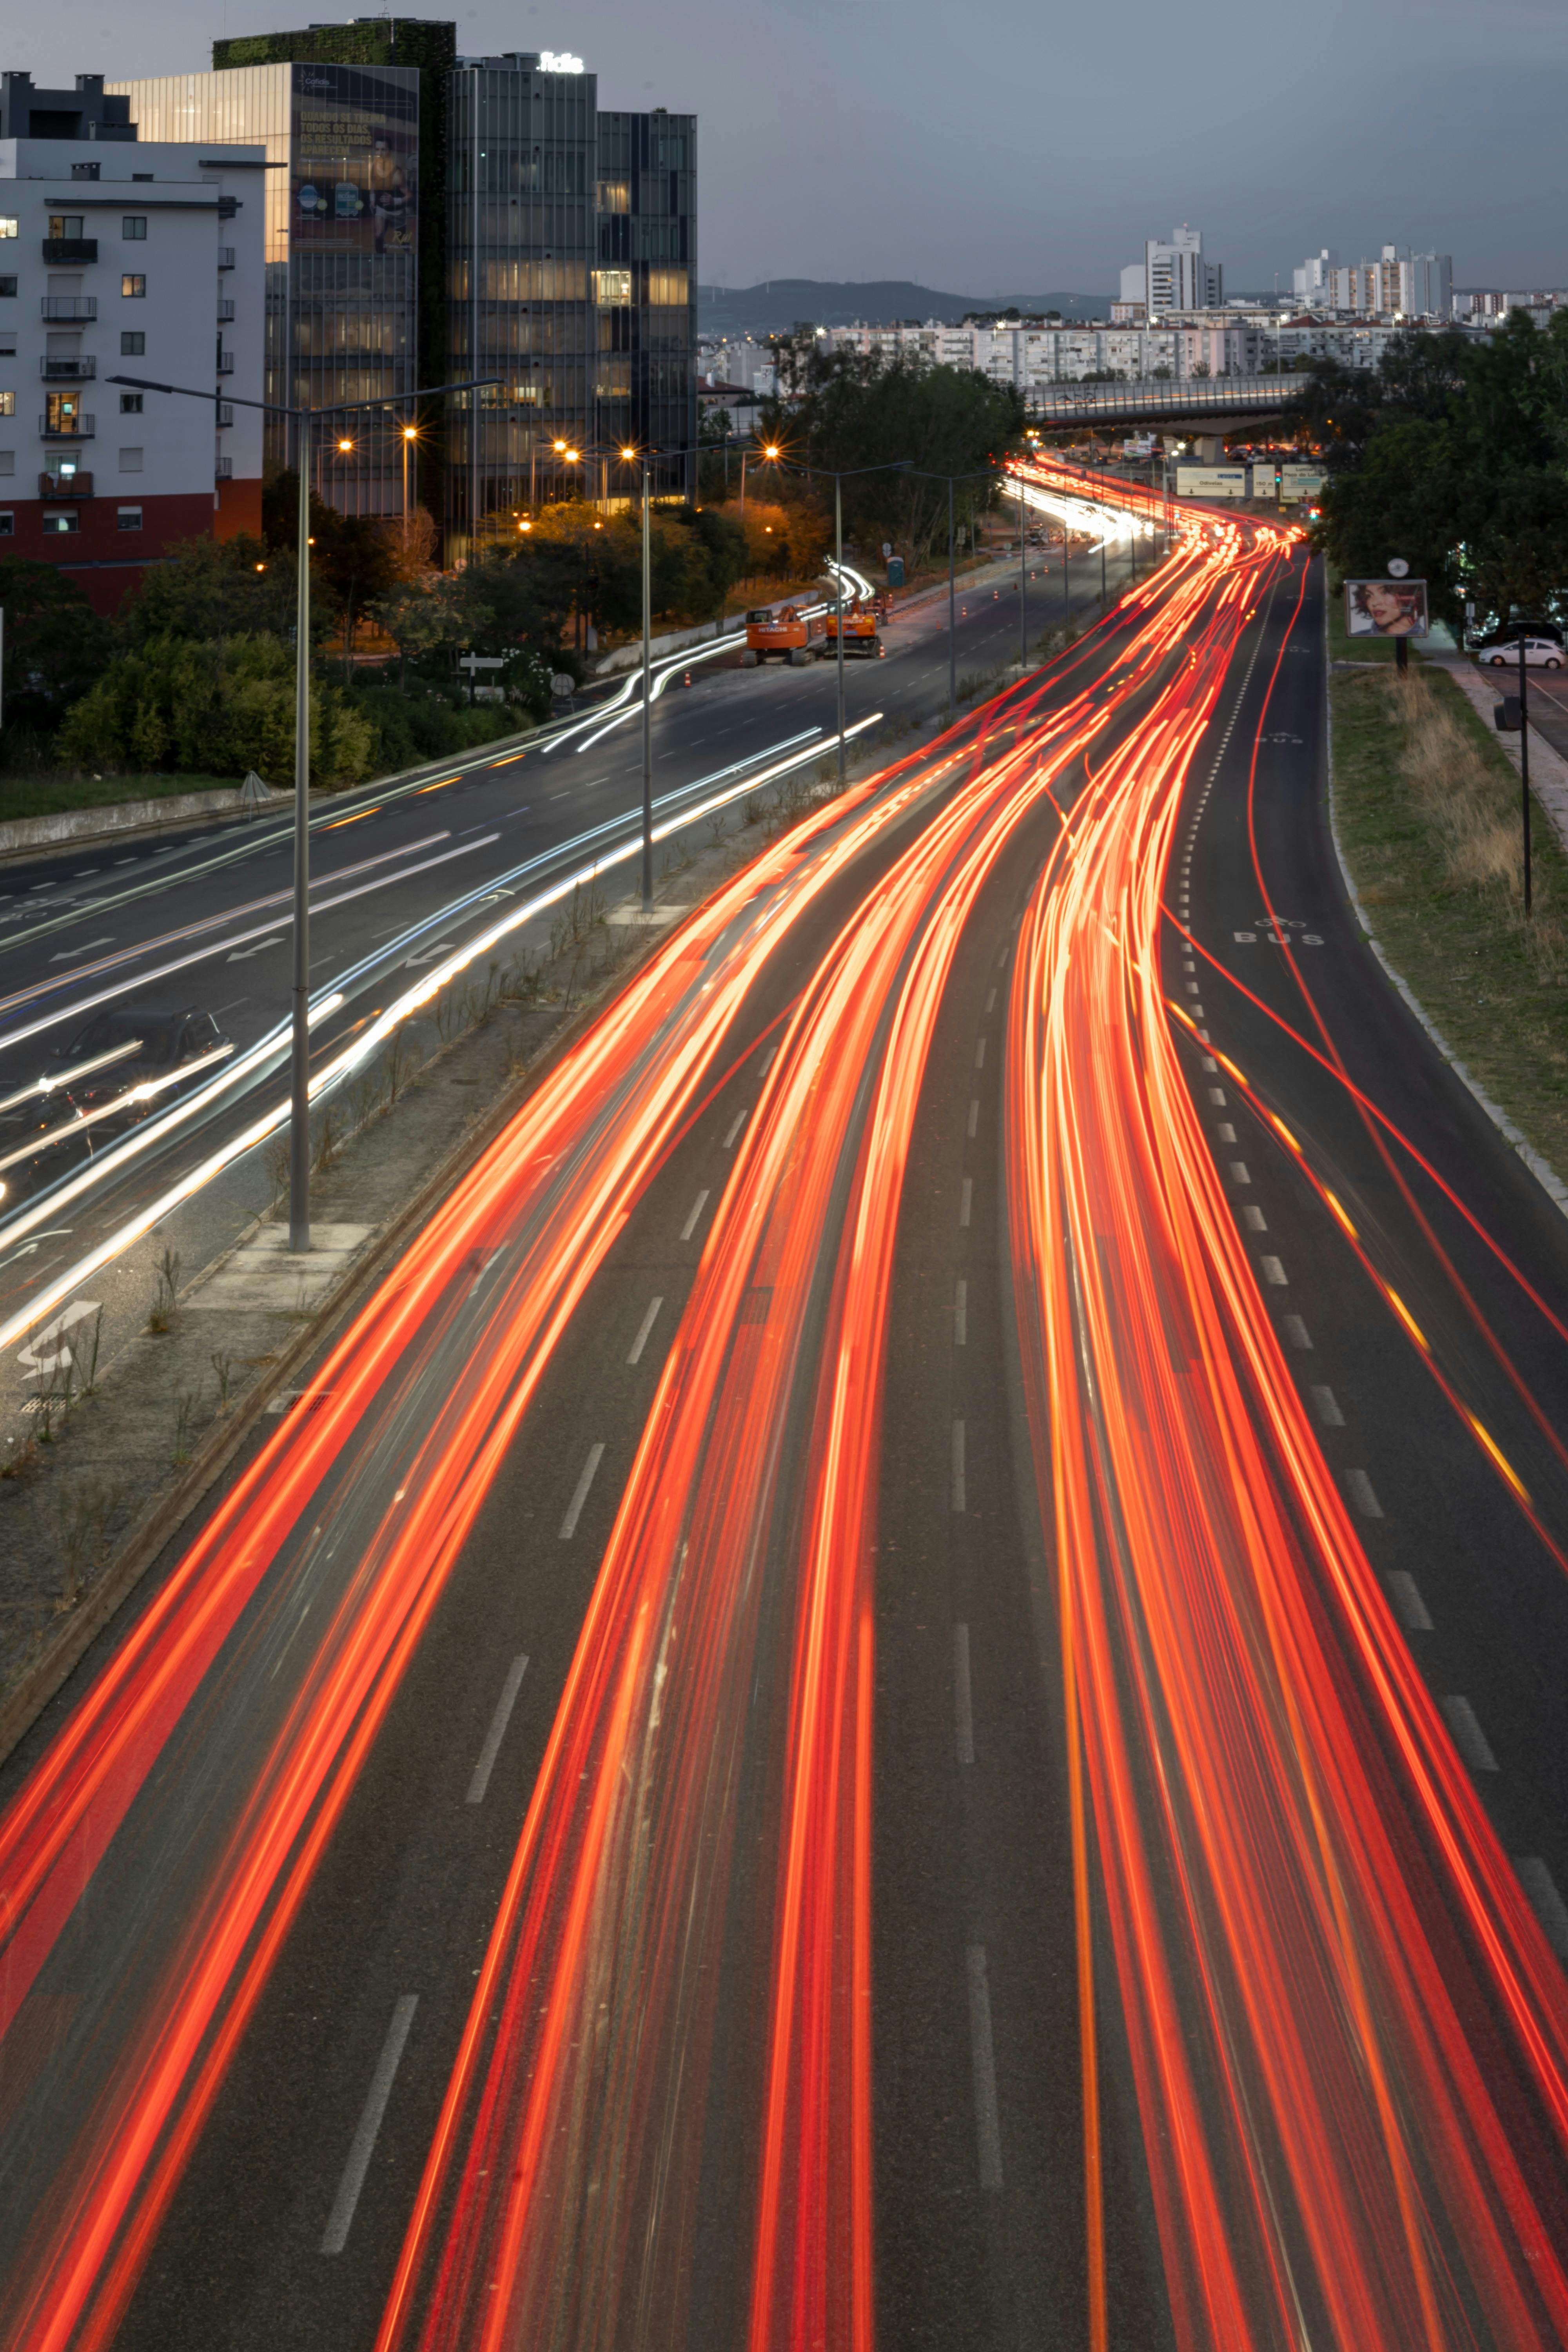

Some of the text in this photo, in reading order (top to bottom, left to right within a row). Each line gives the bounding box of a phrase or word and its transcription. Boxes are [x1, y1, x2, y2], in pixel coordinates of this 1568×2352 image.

[301, 112, 386, 123] QUANDO SE TREINA
[301, 122, 370, 134] TODOS OS DIAS,
[301, 133, 372, 145] OS RESULTADOS
[1233, 932, 1325, 945] BUS
